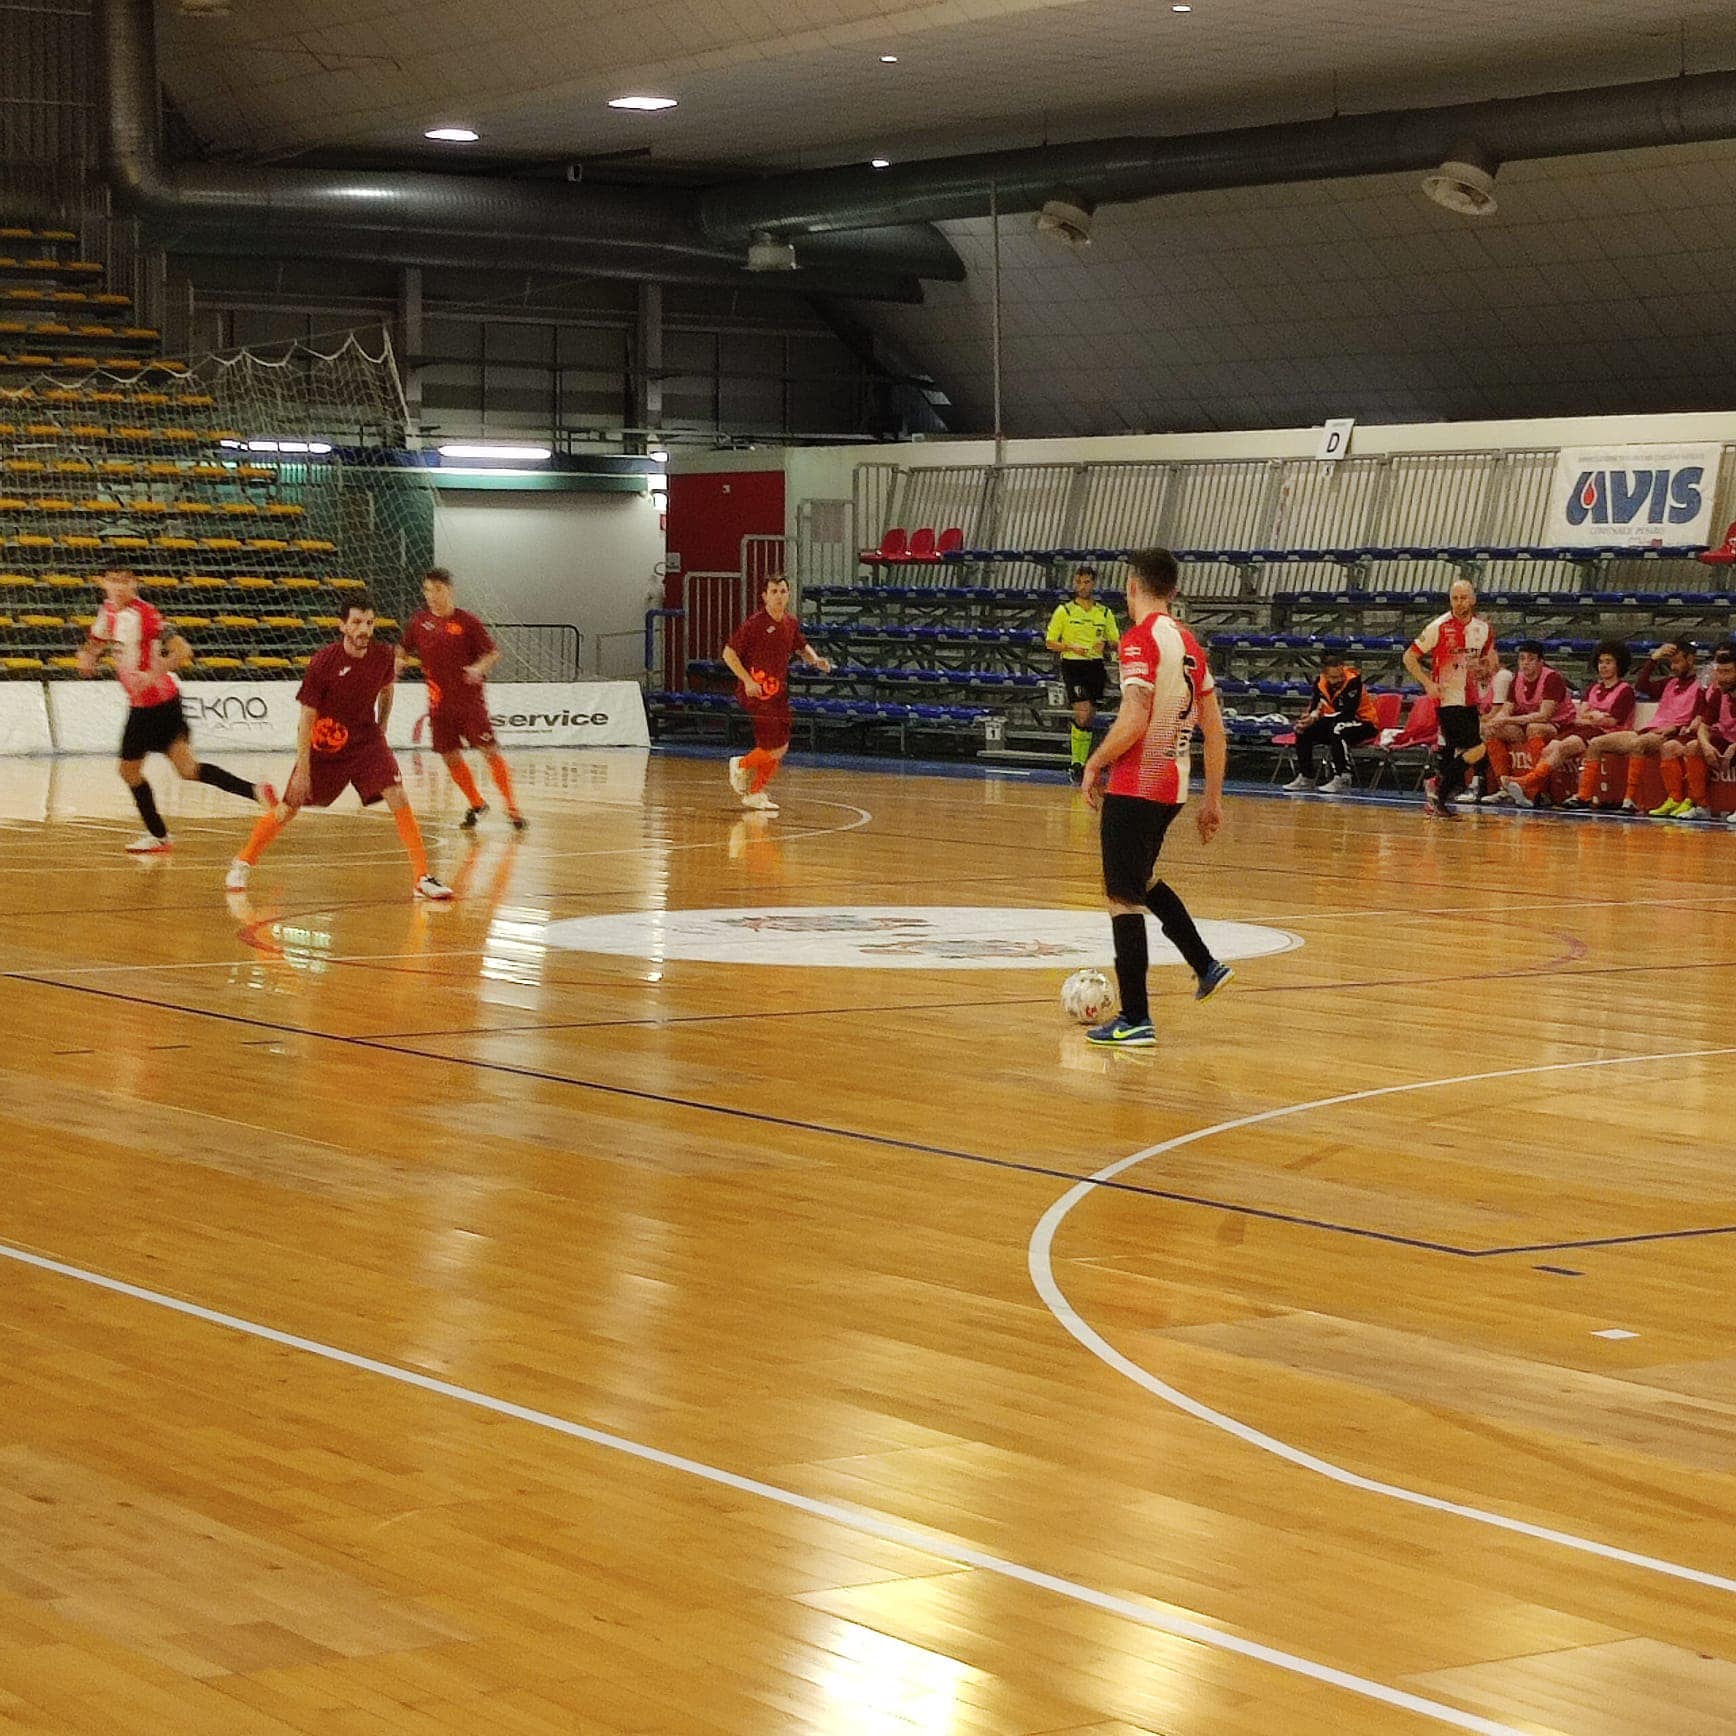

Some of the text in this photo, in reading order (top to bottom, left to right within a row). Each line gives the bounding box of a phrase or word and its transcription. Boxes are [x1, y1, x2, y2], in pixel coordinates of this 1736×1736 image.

[1326, 432, 1340, 453] D
[1566, 466, 1705, 526] AVIS
[489, 709, 609, 727] service
